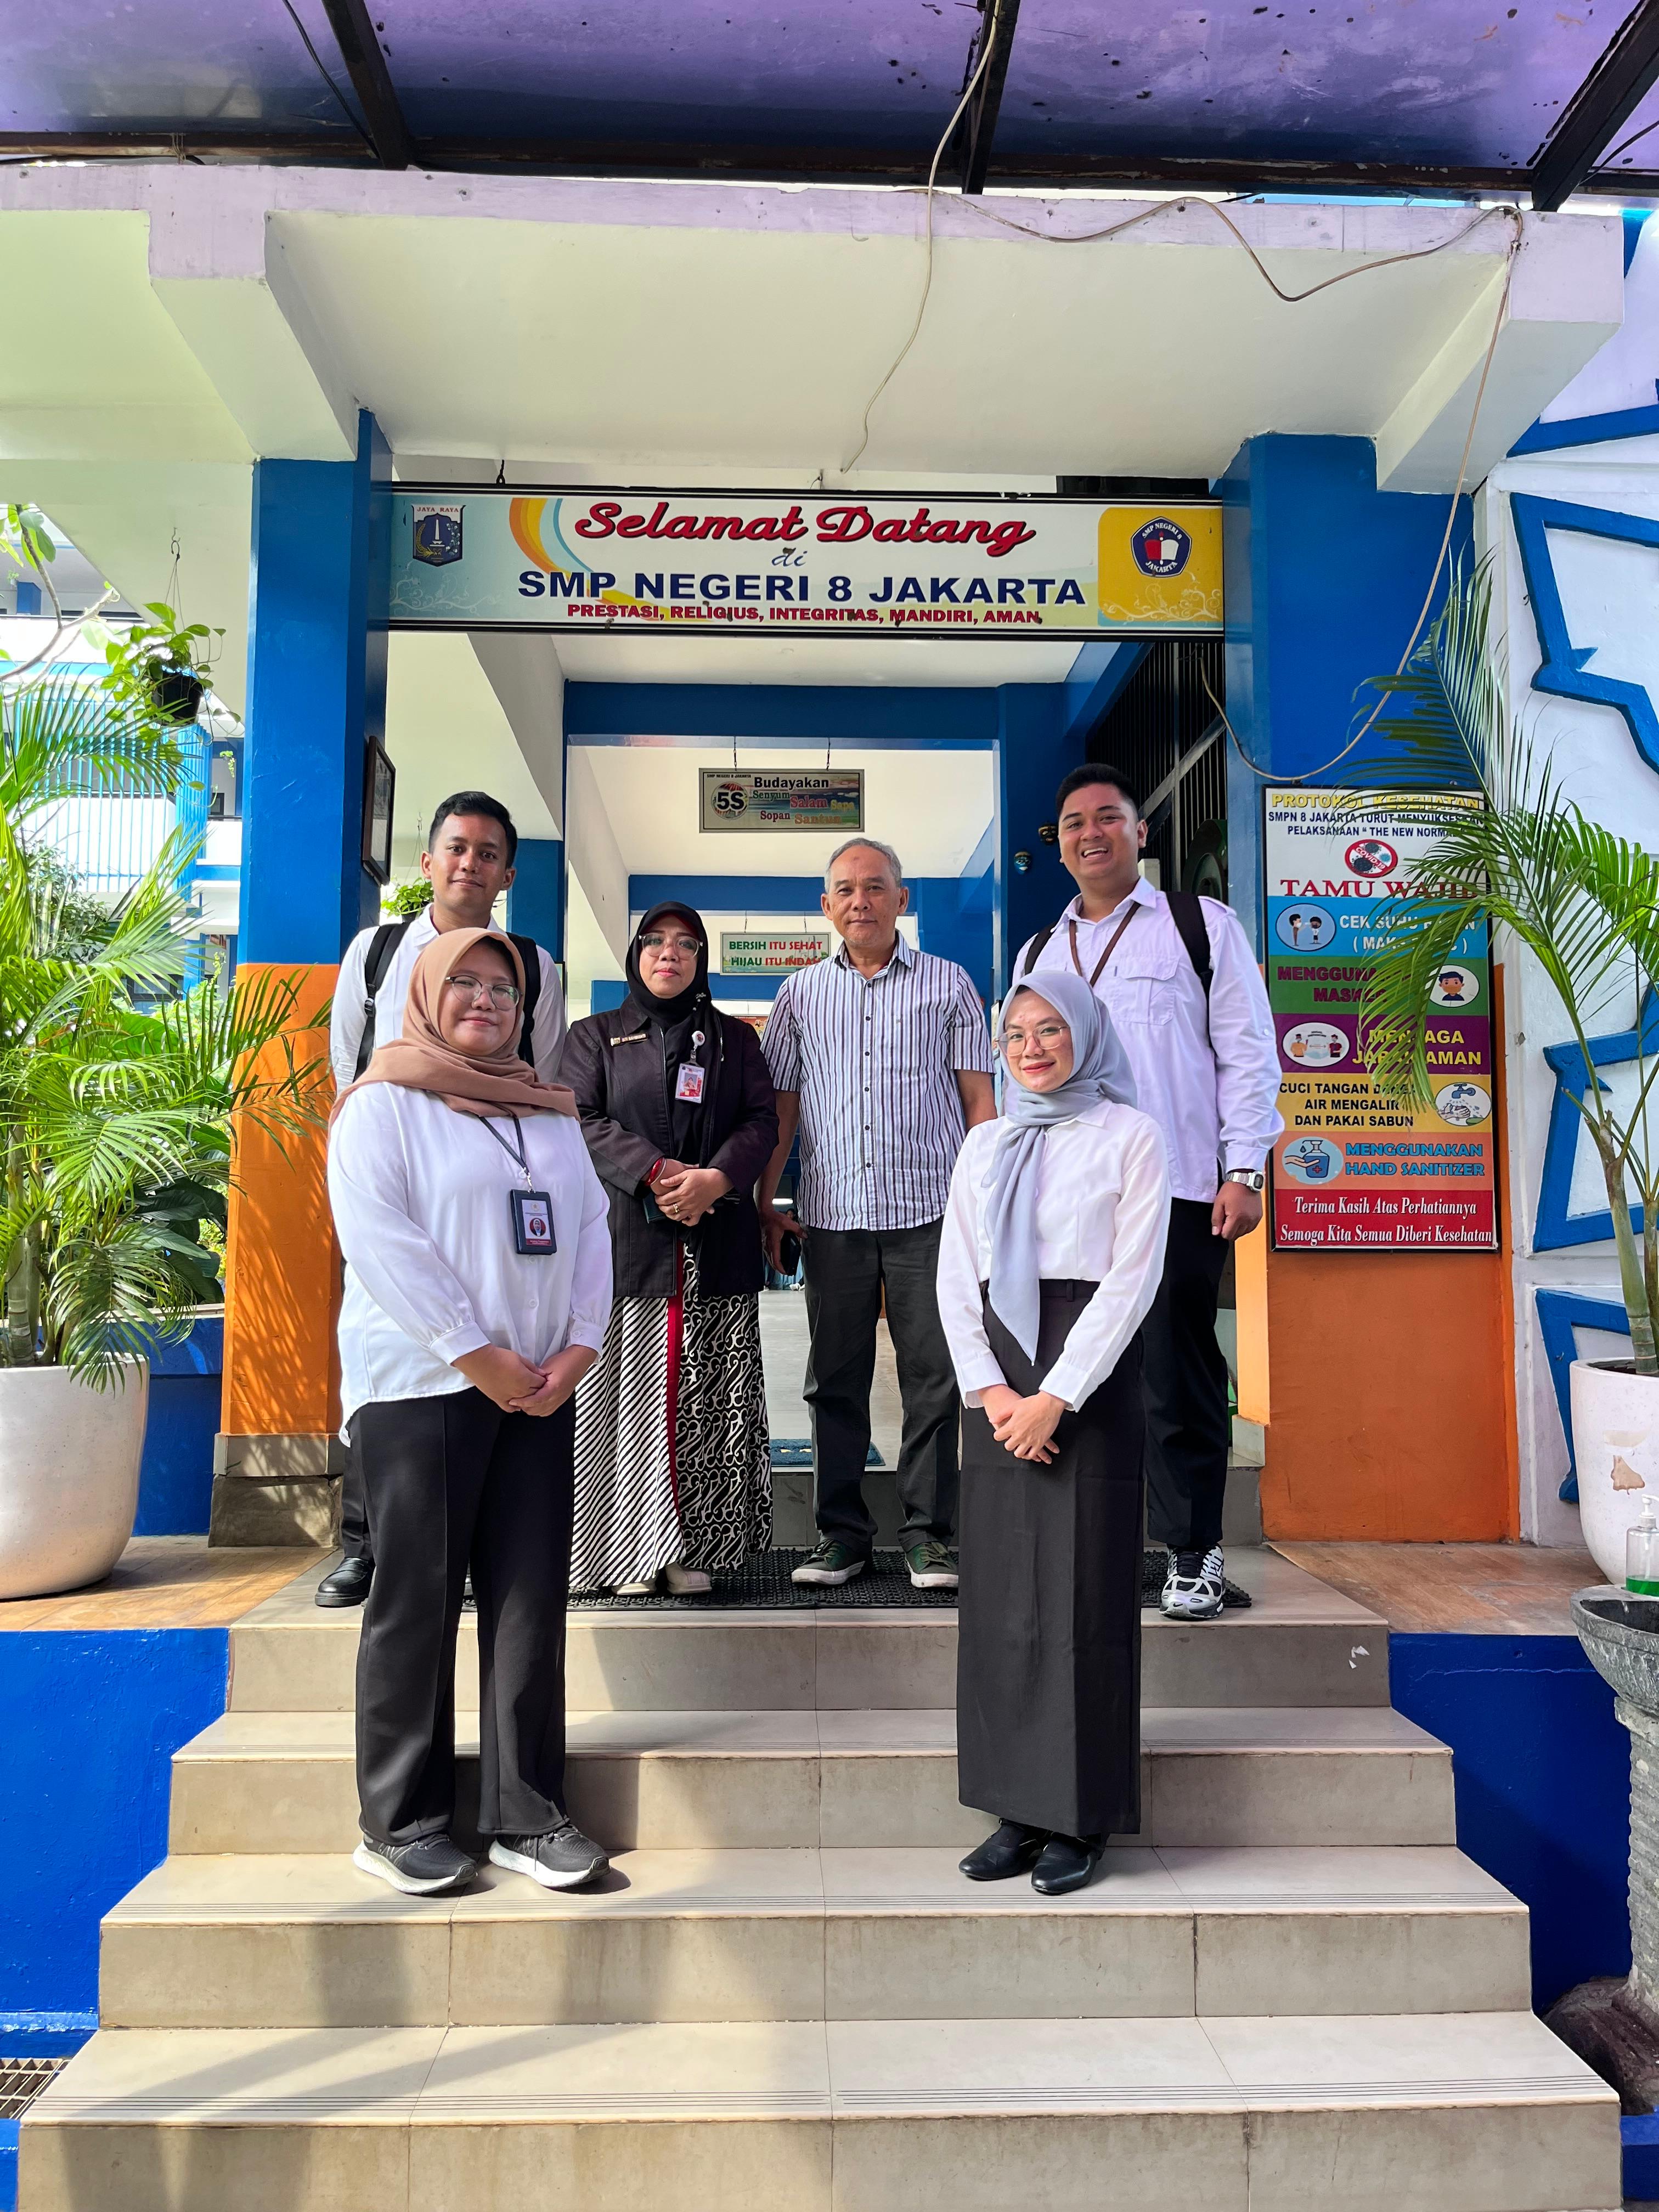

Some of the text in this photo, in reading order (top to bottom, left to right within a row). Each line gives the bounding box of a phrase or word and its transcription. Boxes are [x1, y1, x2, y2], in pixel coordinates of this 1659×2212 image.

[574, 501, 1037, 557] Selamat Datang
[1142, 525, 1154, 538] SMP
[1155, 522, 1179, 535] NEGERI
[771, 547, 808, 567] di
[1146, 561, 1178, 573] JAKARTA
[518, 571, 1087, 605] SMP NEGERI 8 JAKARTA
[567, 605, 665, 620] PRESTASI,
[671, 606, 765, 622] RELIGIUS,
[770, 607, 884, 624] INTEGRITAS,
[890, 609, 978, 625] MANDIRI,
[754, 777, 829, 790] Budayakan
[716, 792, 744, 810] 5S
[753, 790, 790, 802] Senyum
[790, 796, 827, 808] Salam
[1272, 793, 1480, 810] PROTOKOL KESEHATAN
[760, 810, 842, 824] Sopan Santun
[1268, 812, 1297, 822] SMPN
[1301, 812, 1306, 822] 8
[1310, 812, 1357, 823] JAKARTA
[1288, 826, 1359, 836] PELAKSANAAN
[1370, 827, 1389, 836] THE
[1392, 827, 1414, 837] NEW
[1356, 847, 1386, 870] COVID-19
[1280, 879, 1374, 898] TAMU
[1340, 915, 1370, 929] CEK
[729, 941, 822, 950] BERSIH ITU SEHAT
[731, 957, 762, 966] HIJAU
[765, 957, 781, 966] ITU
[1369, 1029, 1464, 1043] MENAGA
[1426, 1051, 1481, 1065] AMAN
[1279, 1083, 1310, 1093] CUCI
[1315, 1083, 1369, 1094] TANGAN
[1305, 1099, 1400, 1110] AIR MENGALIR
[1295, 1115, 1414, 1127] DAN PAKAI SABUN
[1345, 1143, 1483, 1156] MENGGUNAKAN
[1345, 1163, 1485, 1176] HAND SANITIZER
[1295, 1197, 1476, 1220] Terima Kasih Atas Perhatiannya
[1280, 1224, 1492, 1246] Semoga Kita Semua Diberi Kesehatan
